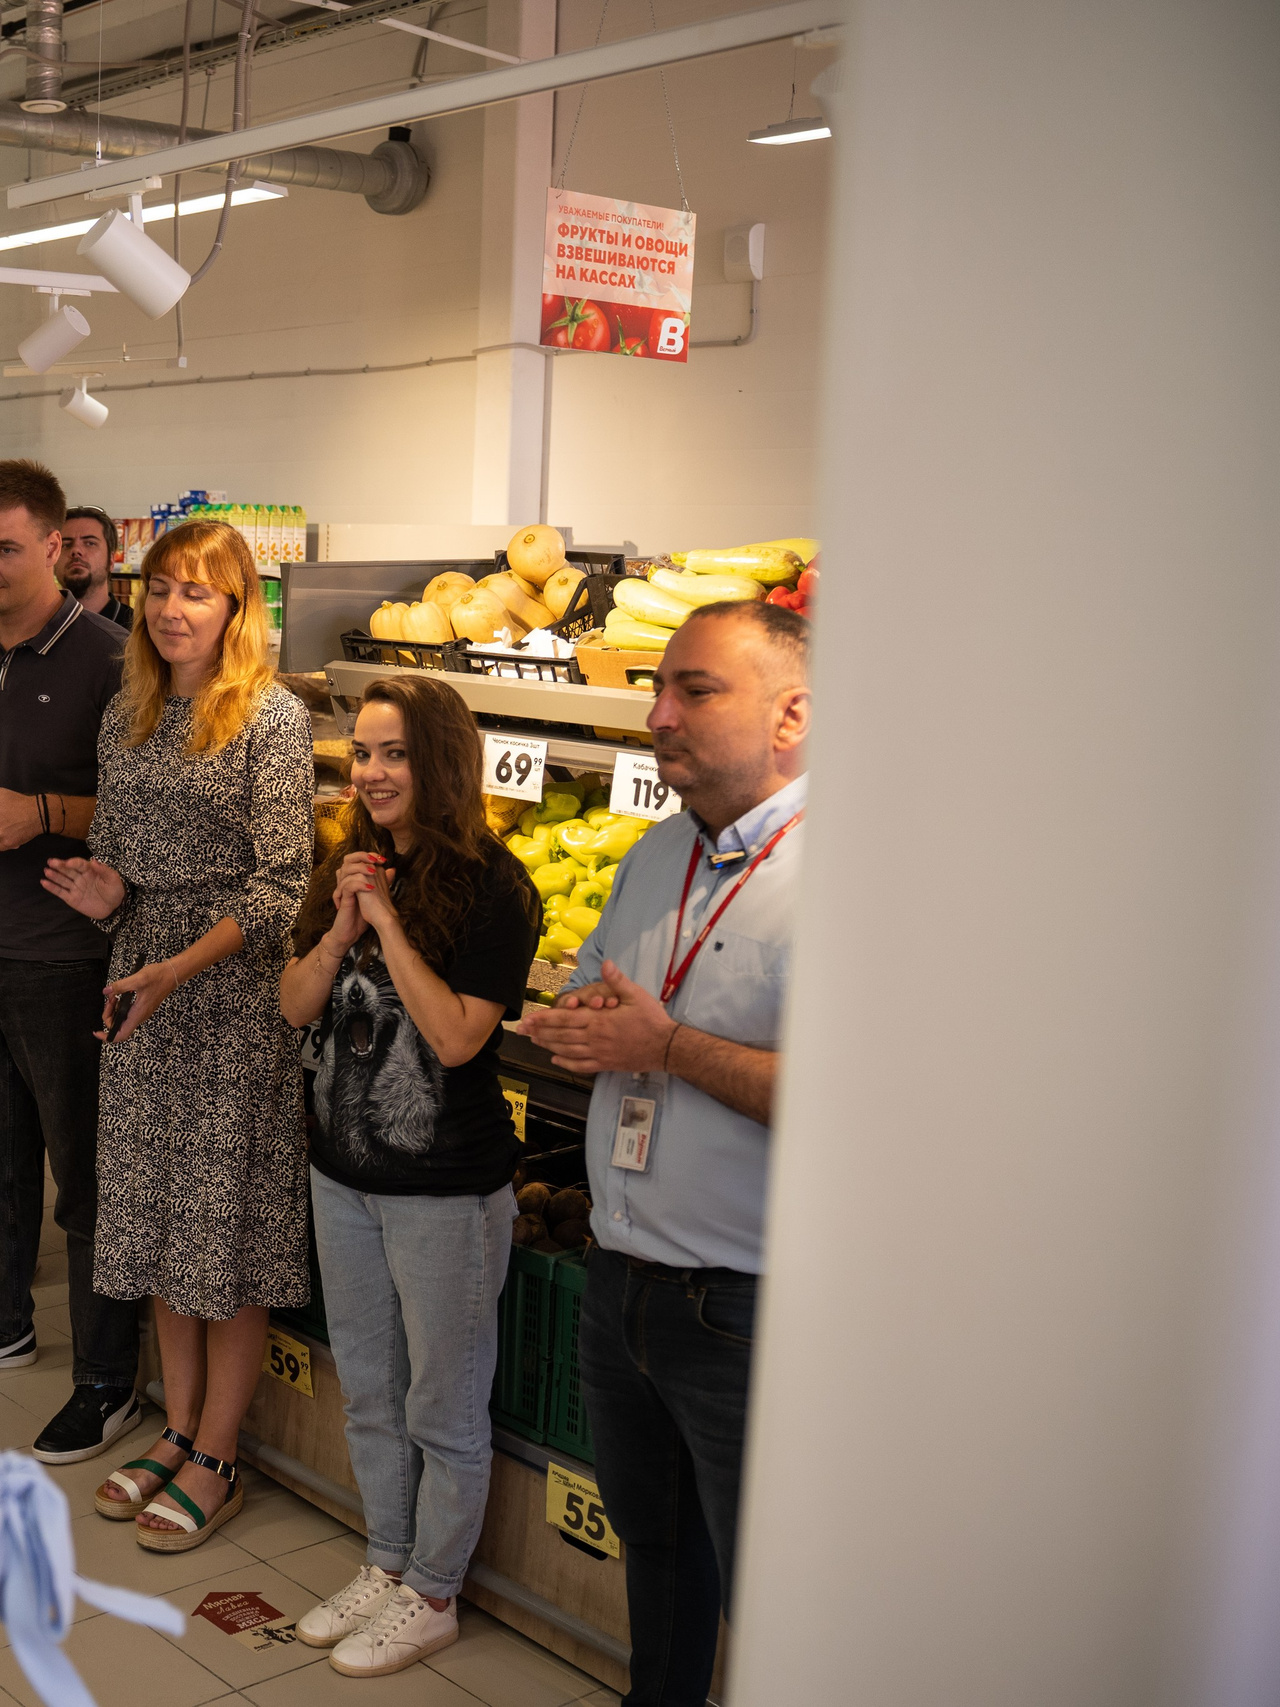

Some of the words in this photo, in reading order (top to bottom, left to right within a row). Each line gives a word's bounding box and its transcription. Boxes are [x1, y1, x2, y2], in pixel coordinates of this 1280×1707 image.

[558, 205, 610, 222] УВАЖАЕМЫЕ
[611, 214, 664, 231] ПОКУПАТЕЛИ!
[557, 222, 619, 246] ФРУКТЫ
[622, 233, 632, 247] И
[635, 236, 688, 257] ОВОЩИ
[557, 244, 676, 275] ВЗВЕШИВАЮТСЯ
[556, 264, 576, 281] НА
[579, 268, 636, 290] КАССАХ
[492, 737, 509, 746] Чеснок
[510, 740, 529, 748] косичка
[495, 750, 532, 786] 69
[533, 757, 542, 766] 99
[632, 777, 669, 811] 119
[515, 1101, 524, 1111] 99
[270, 1344, 300, 1383] 59
[300, 1361, 309, 1371] 99
[563, 1492, 606, 1541] 55
[203, 1593, 245, 1610] Мясная
[217, 1601, 249, 1614] Лавка
[237, 1615, 270, 1629] МЯСА
